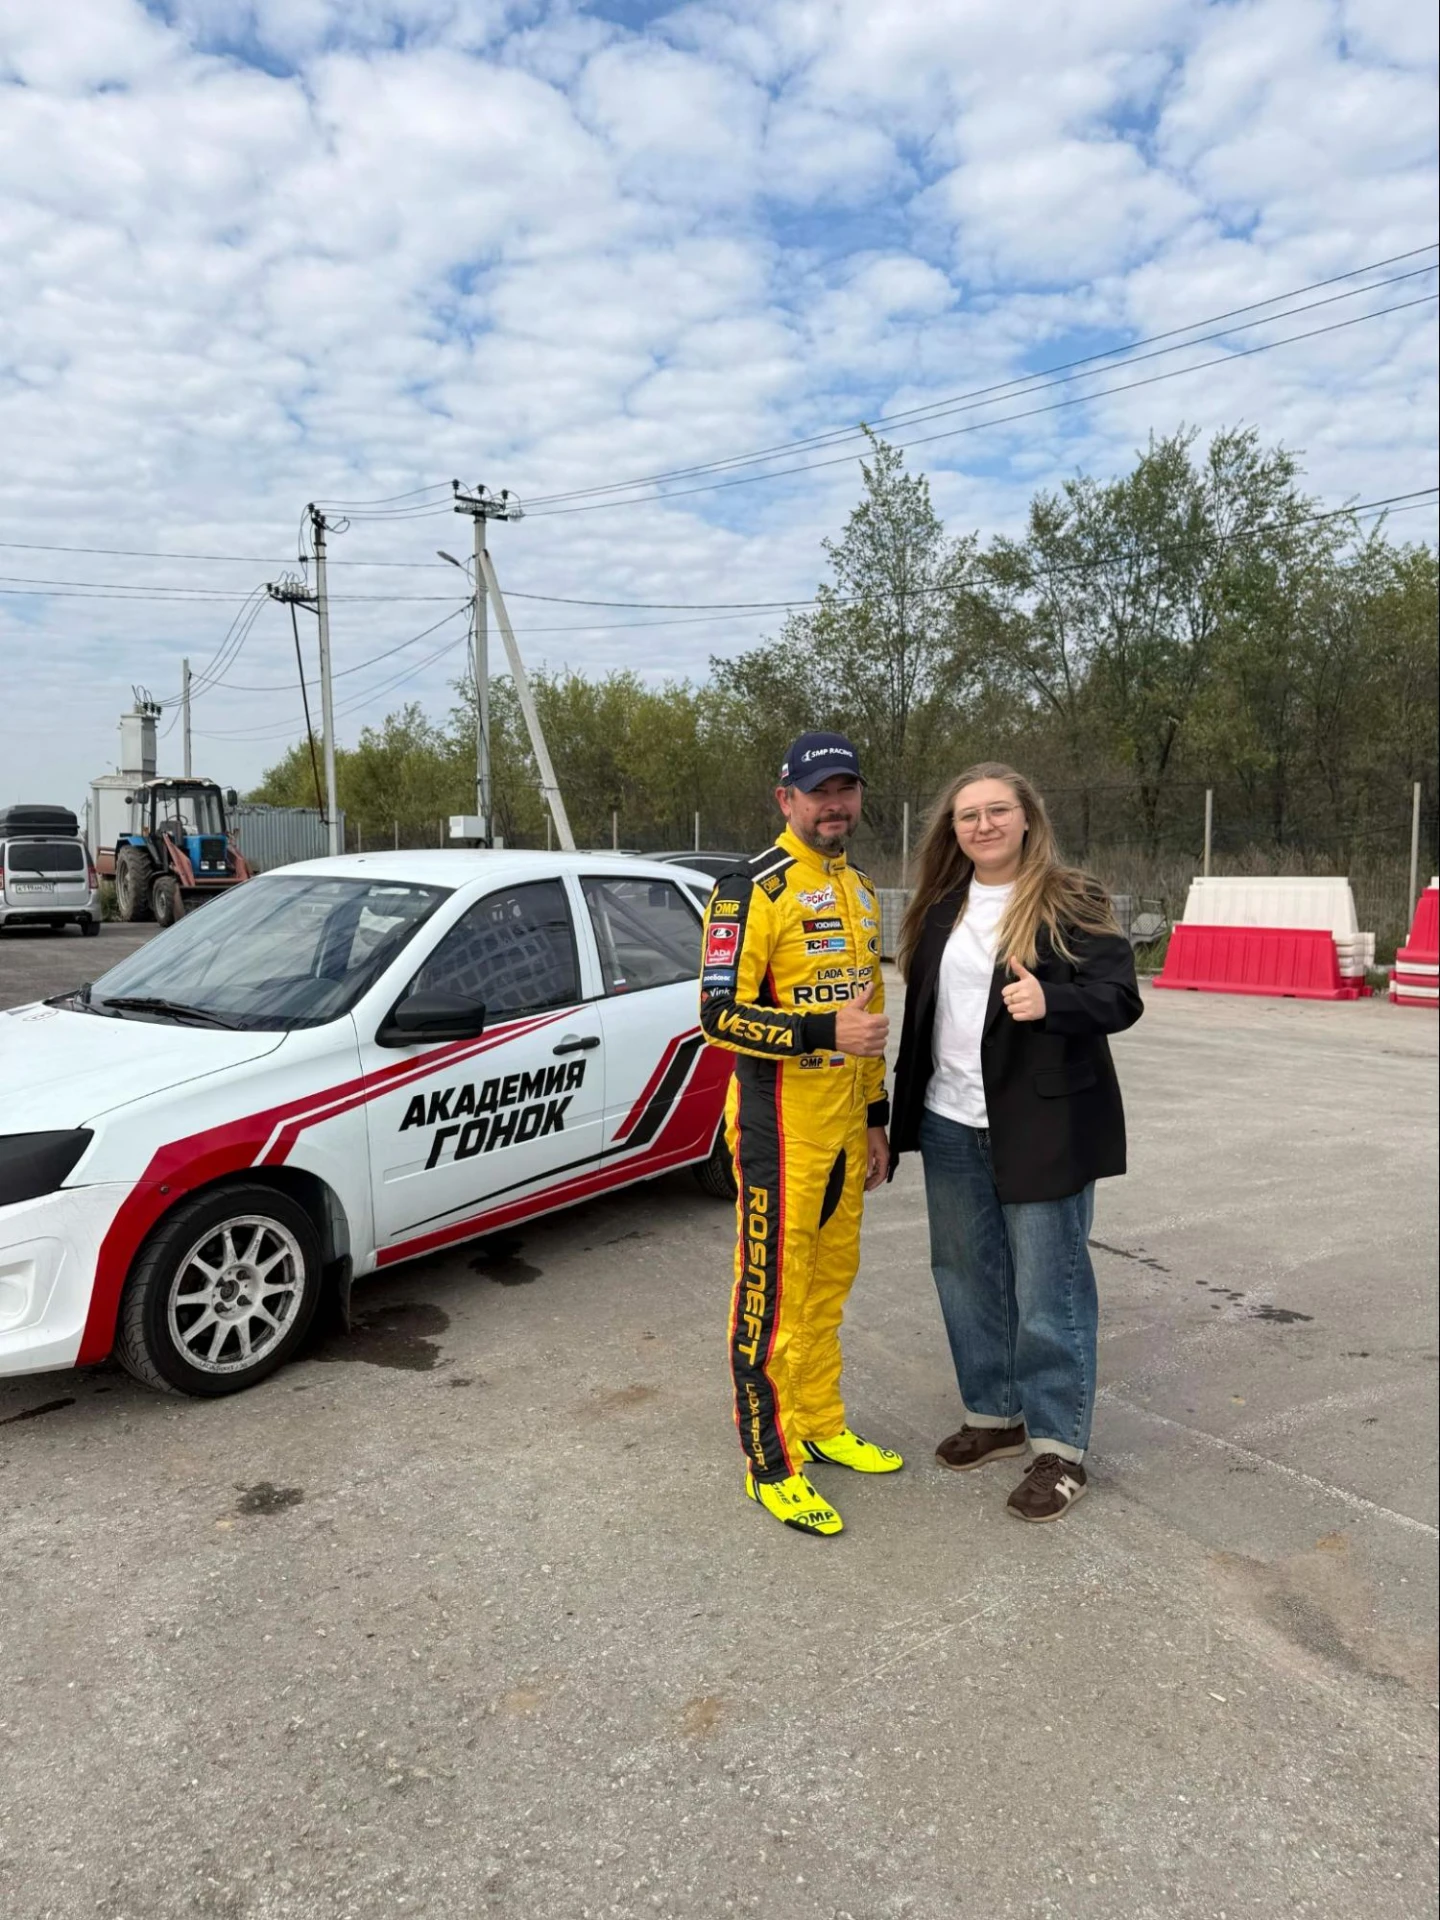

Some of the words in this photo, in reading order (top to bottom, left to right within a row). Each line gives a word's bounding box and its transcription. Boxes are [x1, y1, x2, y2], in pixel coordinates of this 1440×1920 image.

[811, 748, 828, 758] SMP
[763, 876, 780, 891] OMP
[715, 903, 739, 914] OMP
[806, 939, 829, 950] TCR
[708, 949, 731, 957] LADA
[817, 968, 843, 980] LADA
[717, 1009, 794, 1048] VESTA
[800, 1057, 823, 1067] OMP
[398, 1058, 587, 1132] АКАДЕМИЯ
[424, 1094, 575, 1171] ГОНОК
[738, 1185, 768, 1366] ROSNEFT
[796, 1511, 834, 1525] OMP
